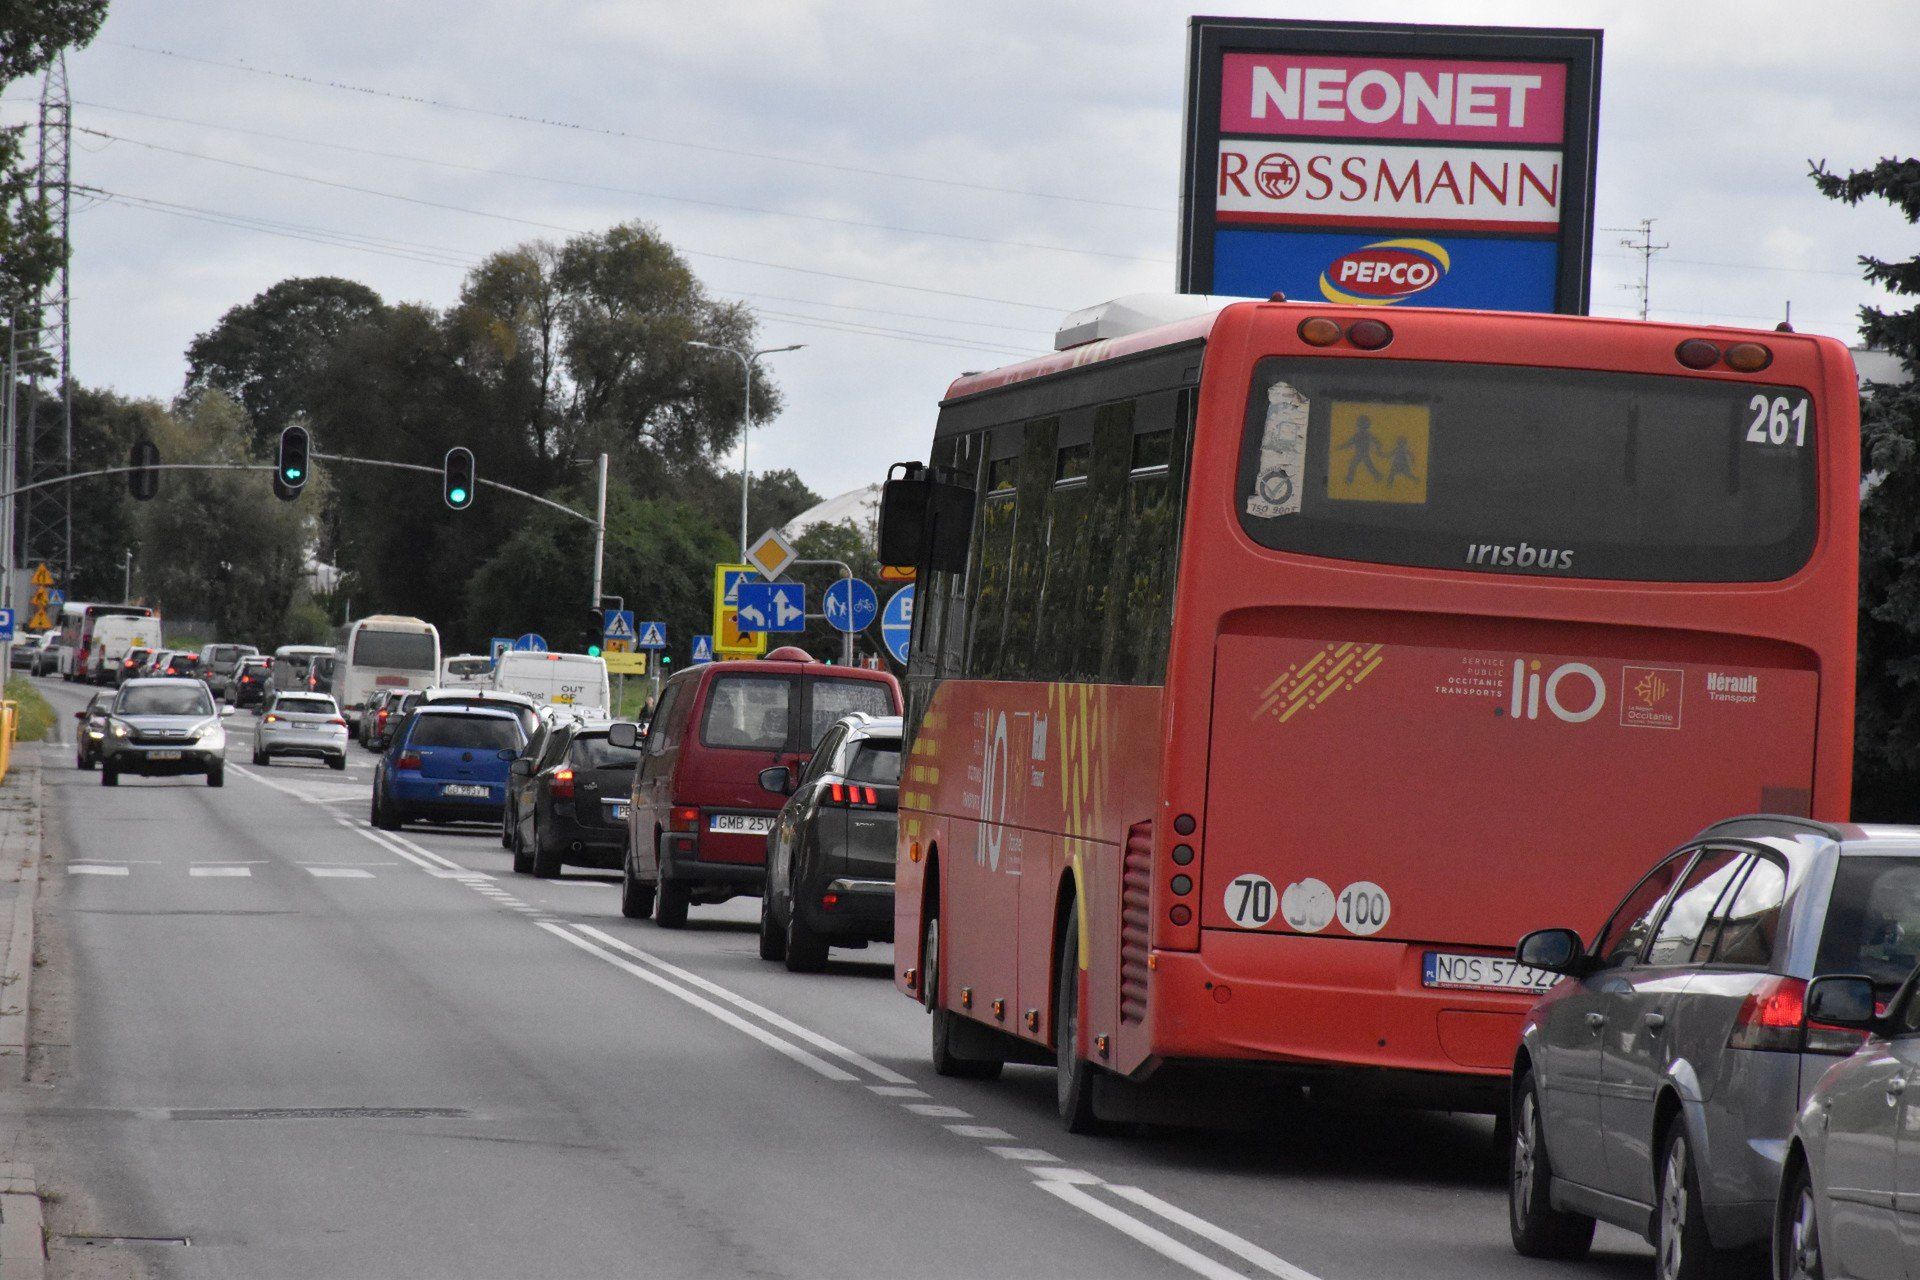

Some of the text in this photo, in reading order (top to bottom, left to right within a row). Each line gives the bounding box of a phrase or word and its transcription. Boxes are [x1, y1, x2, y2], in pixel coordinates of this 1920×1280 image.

[1250, 66, 1542, 128] NEONET
[1219, 152, 1559, 208] ROSSMANN
[1339, 260, 1431, 285] PEPCO
[1745, 394, 1808, 447] 261
[1465, 542, 1575, 570] irisbus
[1462, 657, 1504, 667] SERVICE
[1467, 667, 1504, 677] PUBLIC
[1435, 686, 1502, 698] TRANSPORTS
[1448, 677, 1503, 687] OCCITANIE
[1707, 672, 1757, 693] Hérault
[1709, 692, 1756, 703] Transport
[1628, 711, 1673, 721] Occitanie
[719, 816, 744, 830] GMB
[1235, 880, 1271, 922] 70
[1343, 891, 1384, 926] 100
[1438, 956, 1482, 982] NOS
